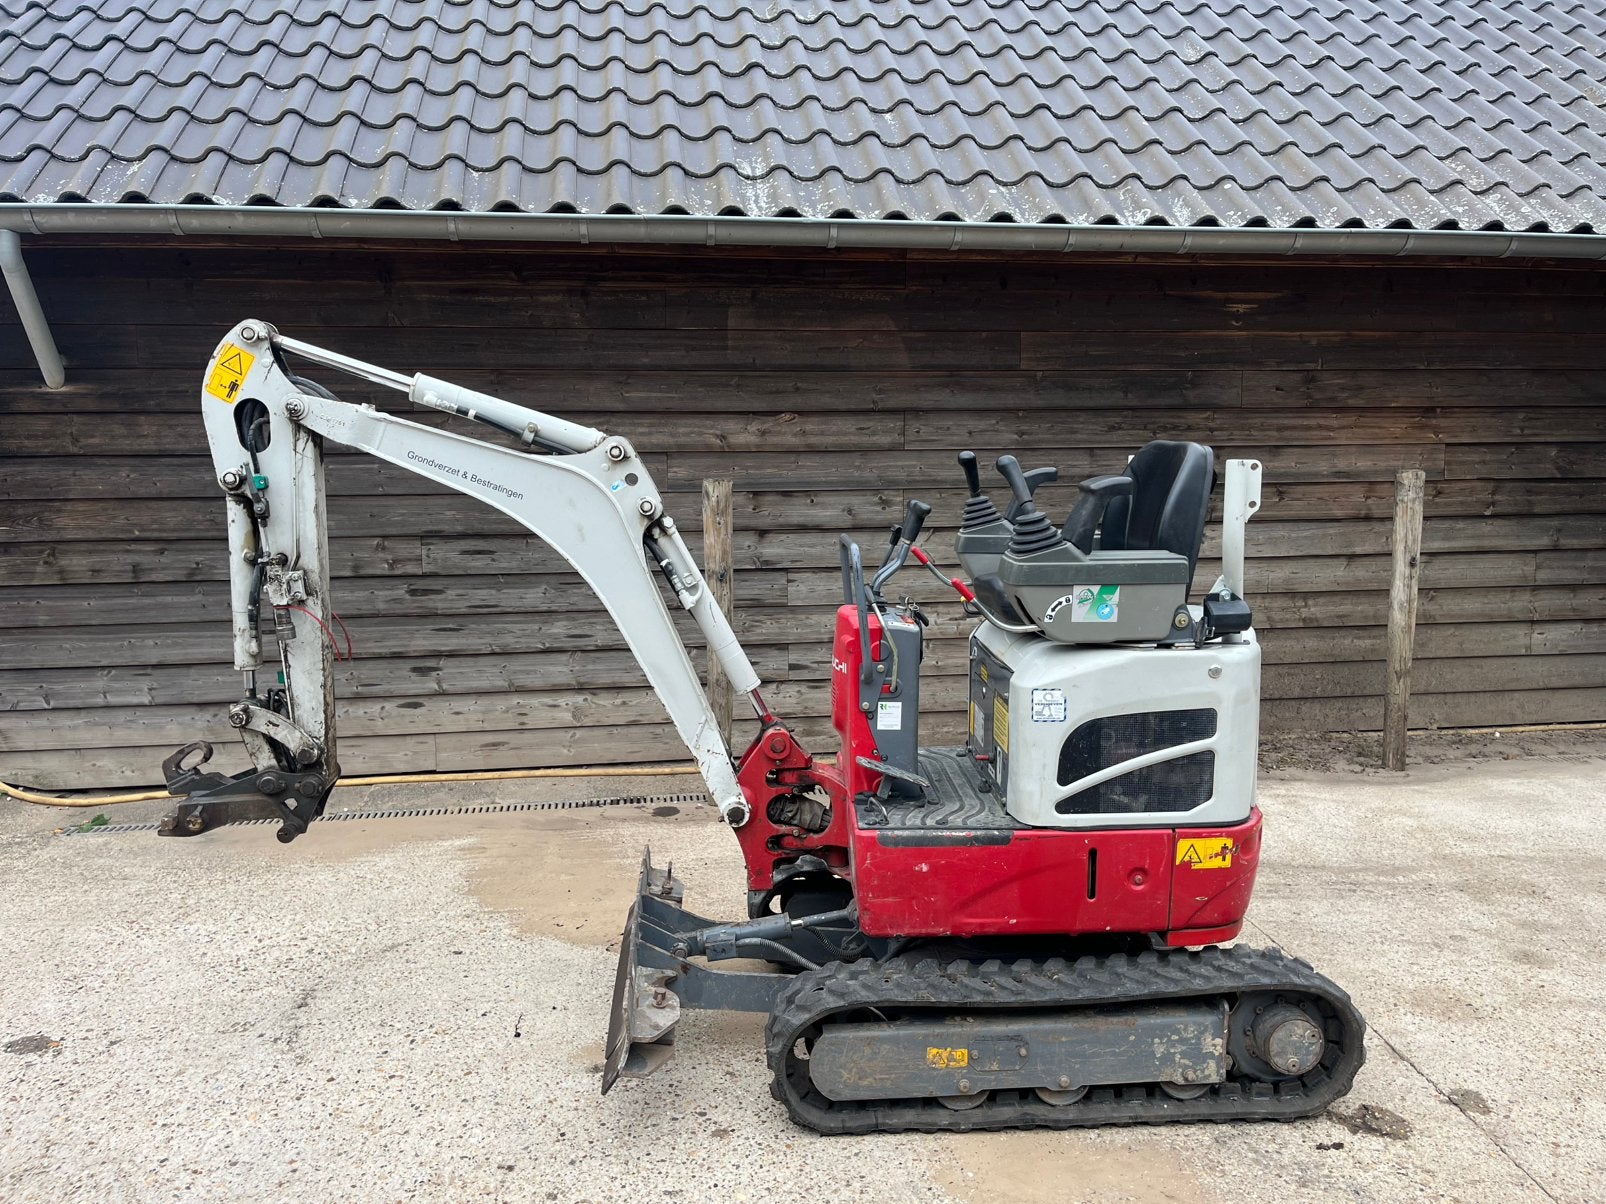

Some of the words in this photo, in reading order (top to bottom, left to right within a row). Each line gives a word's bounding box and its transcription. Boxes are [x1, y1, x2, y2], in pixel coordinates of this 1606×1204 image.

[407, 451, 461, 477] Grondverzet
[461, 470, 469, 480] &
[470, 474, 524, 501] Bestratingen
